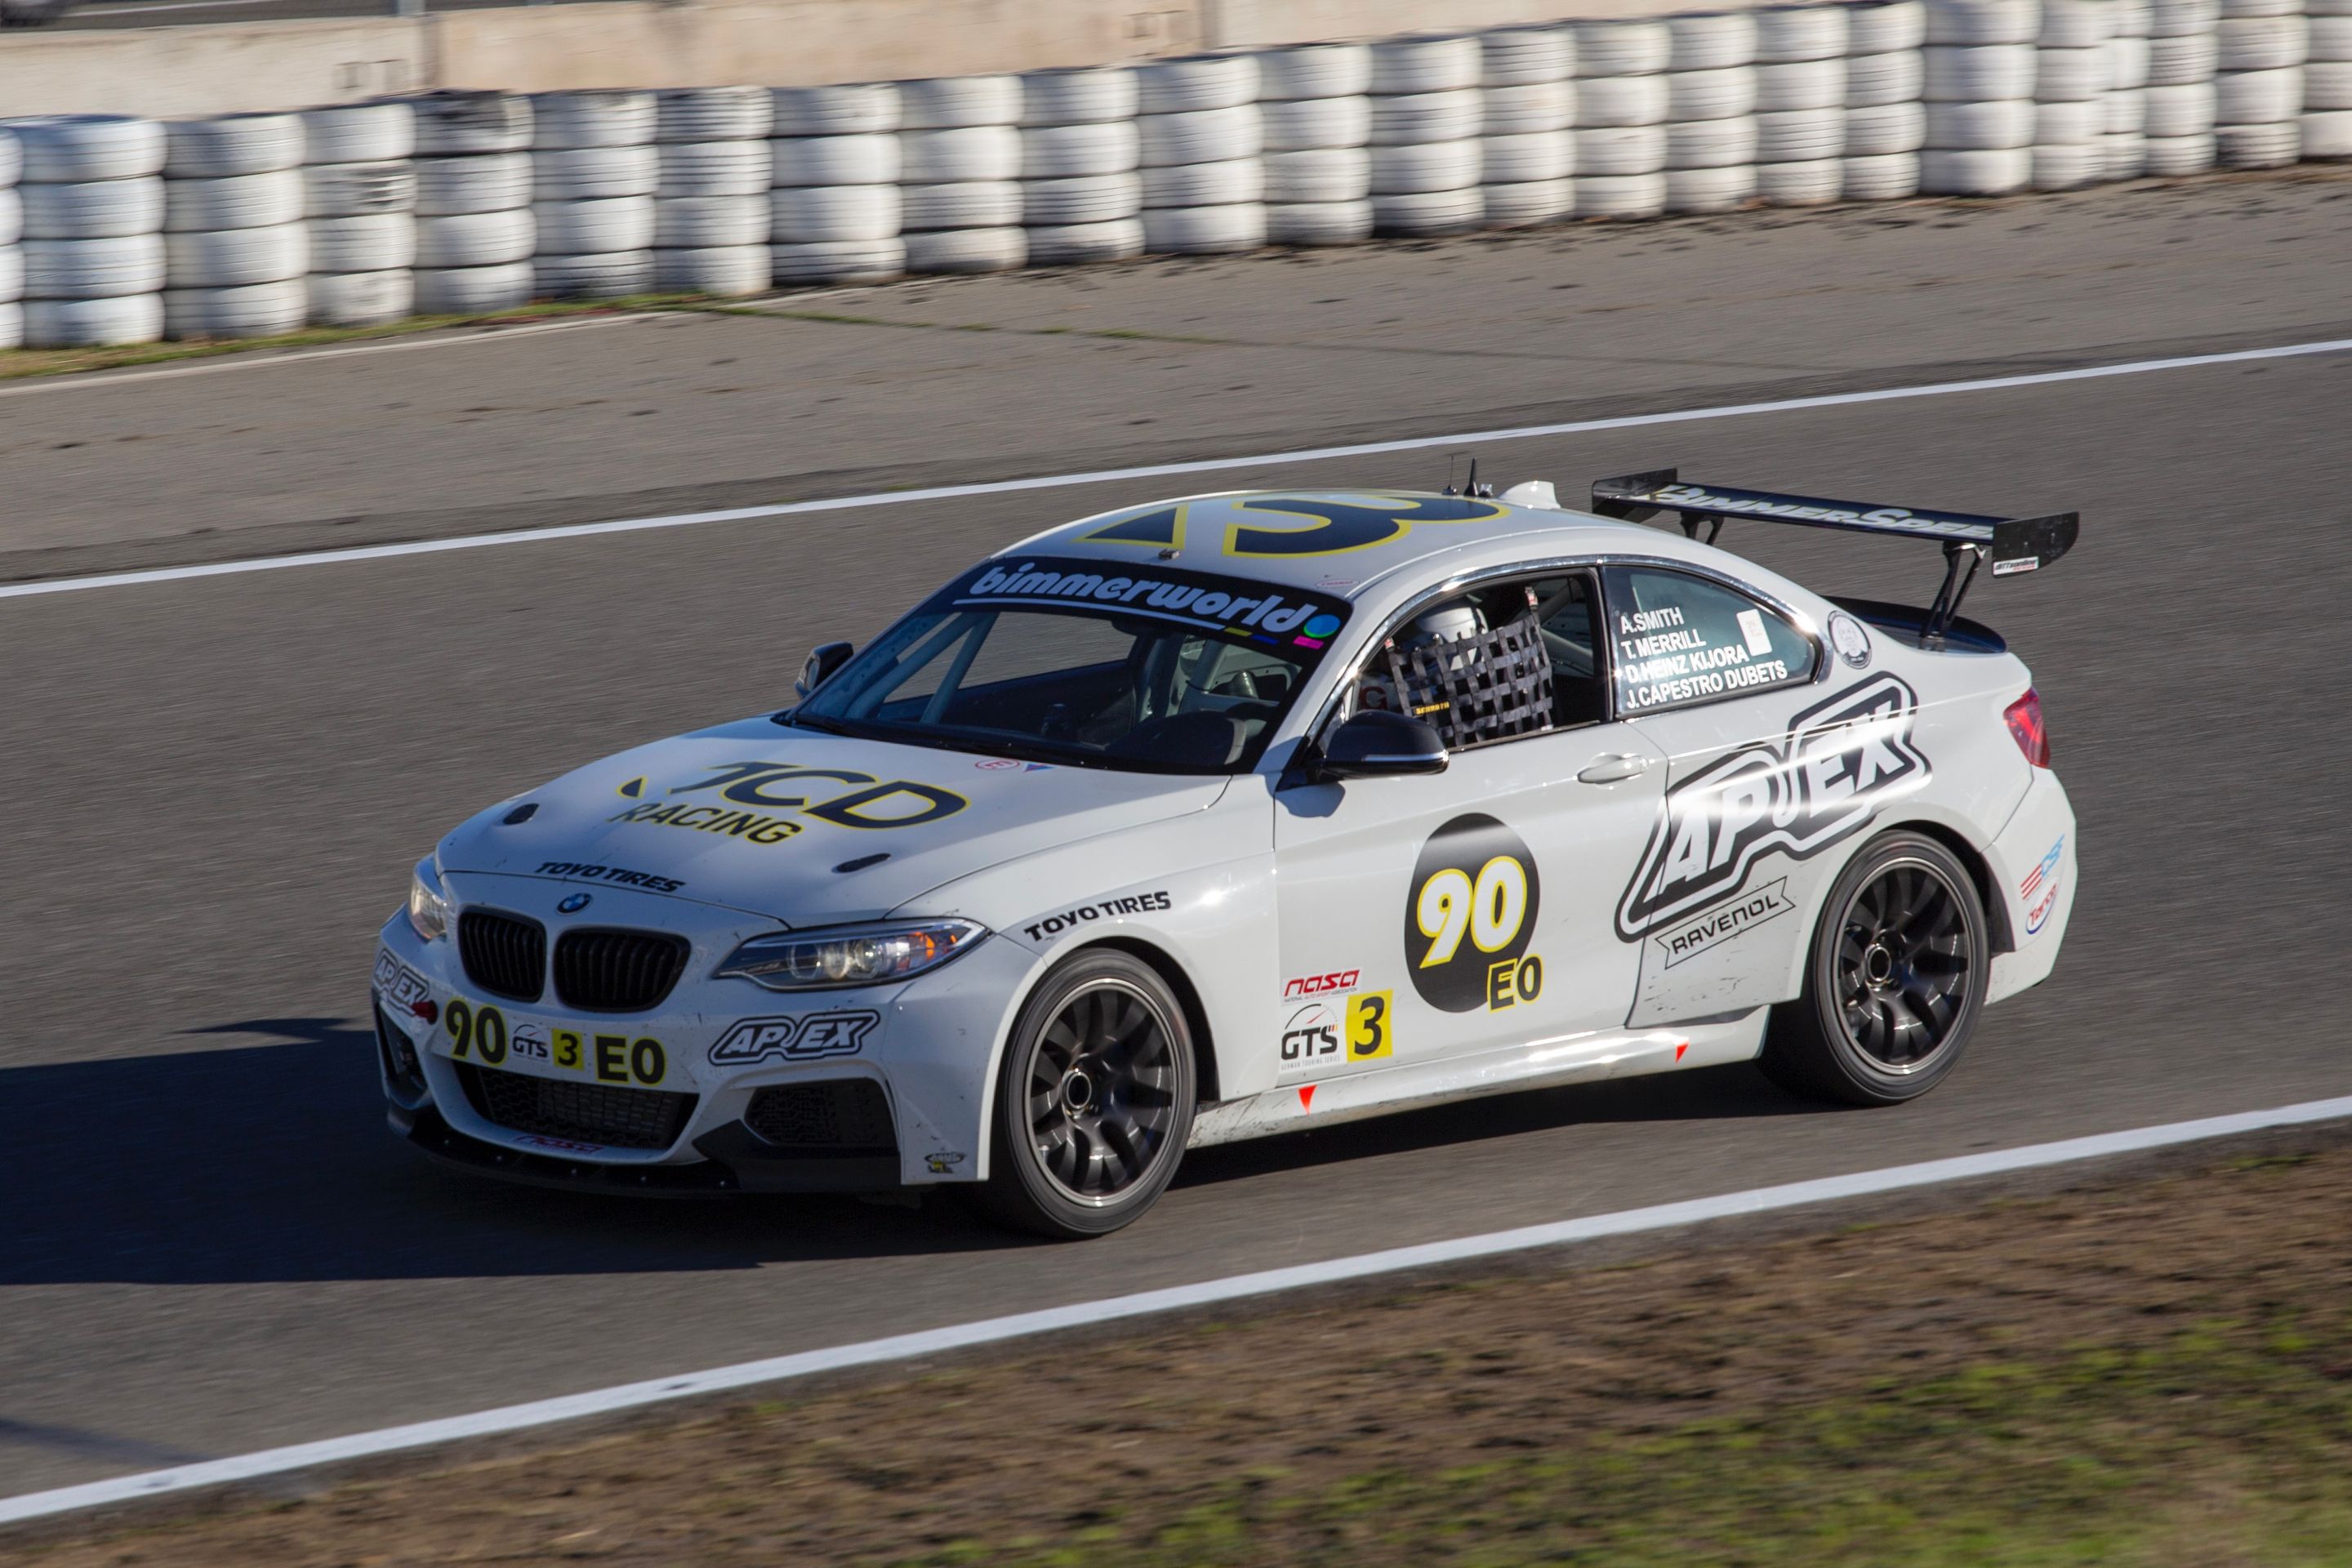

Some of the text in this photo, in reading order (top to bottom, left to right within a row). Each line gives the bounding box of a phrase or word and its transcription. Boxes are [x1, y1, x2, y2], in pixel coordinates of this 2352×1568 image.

[969, 563, 1317, 633] bimmerworld
[1689, 644, 1749, 672] KIJORA
[1725, 660, 1788, 690] DUBETS
[1642, 699, 1906, 904] APEX
[609, 802, 804, 844] RACING
[534, 862, 686, 893] TOYO TIRES
[1024, 891, 1171, 942] TOYO TIRES
[1417, 855, 1528, 969] 90
[445, 997, 507, 1065] 90
[719, 1018, 866, 1057] APEX
[1281, 1025, 1338, 1061] GTS
[1353, 996, 1385, 1056] 3
[512, 1036, 549, 1058] GTS
[557, 1032, 579, 1067] 3
